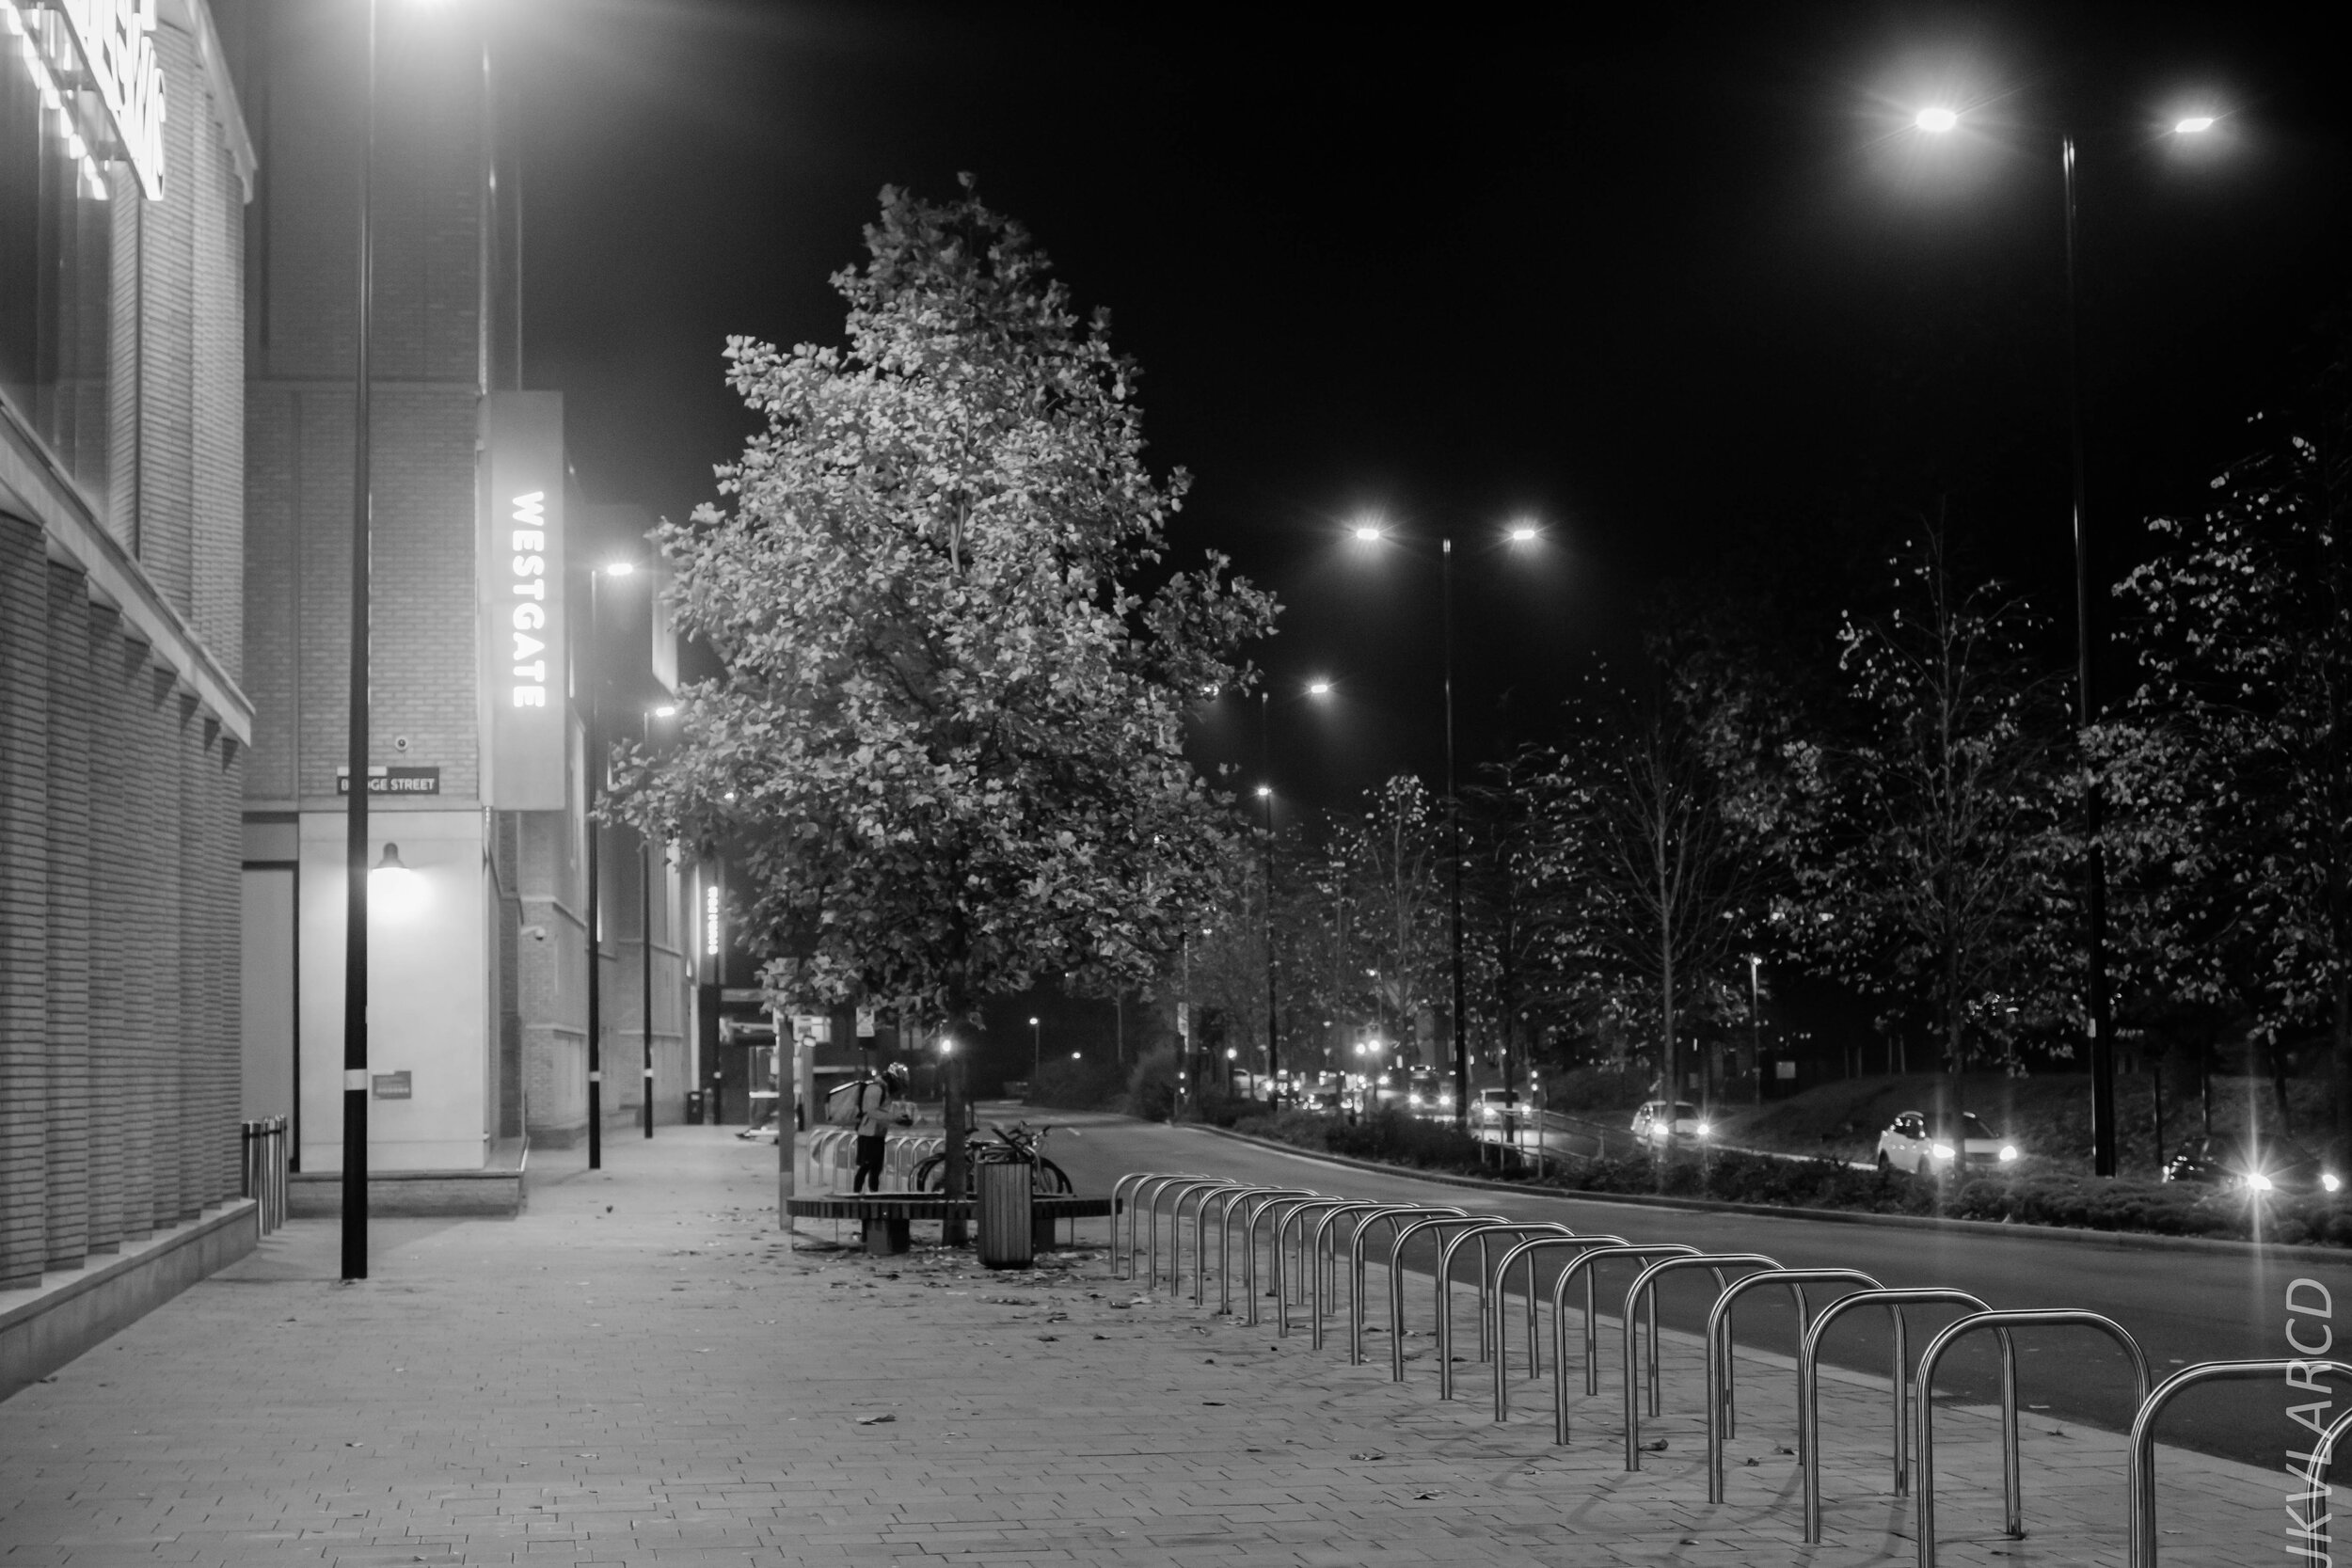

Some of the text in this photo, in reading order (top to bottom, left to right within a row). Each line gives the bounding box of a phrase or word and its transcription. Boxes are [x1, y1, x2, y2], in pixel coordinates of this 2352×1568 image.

[512, 490, 546, 707] WESTGATE
[341, 778, 435, 791] BGE STREET
